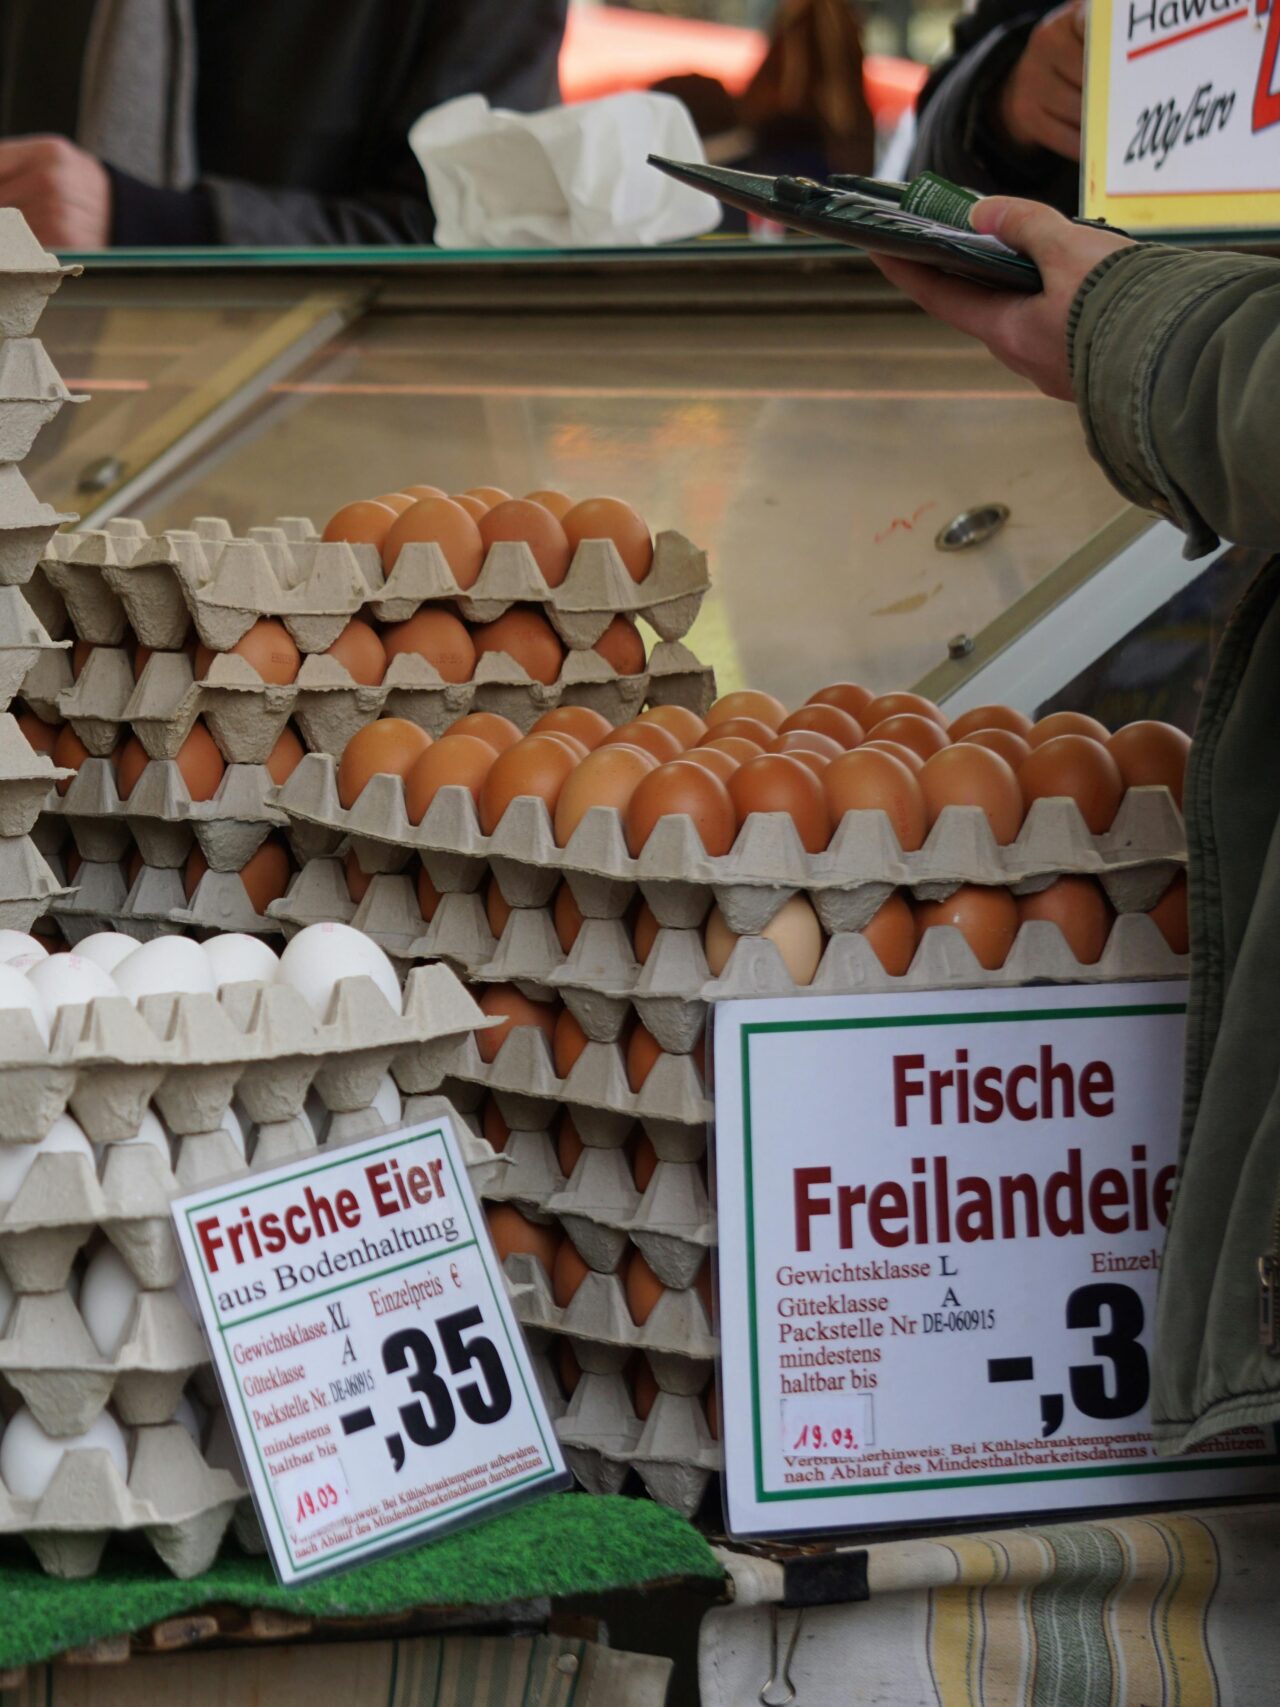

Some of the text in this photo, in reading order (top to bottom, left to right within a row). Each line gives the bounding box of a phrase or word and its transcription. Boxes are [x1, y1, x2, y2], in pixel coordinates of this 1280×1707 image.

[1128, 0, 1252, 41] Haw
[892, 1044, 1115, 1128] Frische
[195, 1158, 446, 1274] Frische Eier
[793, 1144, 1178, 1253] Freilandeie
[218, 1216, 460, 1312] aus Bodenhaltung
[776, 1255, 959, 1287] Gewichtsklasse L
[1091, 1249, 1161, 1273] Einzel
[368, 1263, 462, 1317] Einzelpreis €
[777, 1286, 962, 1318] Güteklasse A
[233, 1301, 350, 1365] Gewichtsklasse XL
[778, 1309, 996, 1343] Packstelle Nr DE-060915
[243, 1334, 357, 1398] Güteklasse A
[779, 1346, 882, 1369] mindestens
[987, 1282, 1150, 1437] -,3
[780, 1368, 878, 1394] haltbar bis
[252, 1395, 311, 1431] Packstelle
[309, 1388, 331, 1410] Nr.
[263, 1423, 331, 1457] mindestens
[784, 1430, 1153, 1467] Verbraerhinweis: Bei Kühlschranktemperatu
[268, 1441, 338, 1477] haltbar bis
[784, 1467, 825, 1484] nach
[830, 1462, 890, 1481] Ablauf
[894, 1460, 922, 1476] des
[295, 1541, 318, 1559] nach
[320, 1526, 353, 1550] Ablauf
[355, 1522, 372, 1536] des
